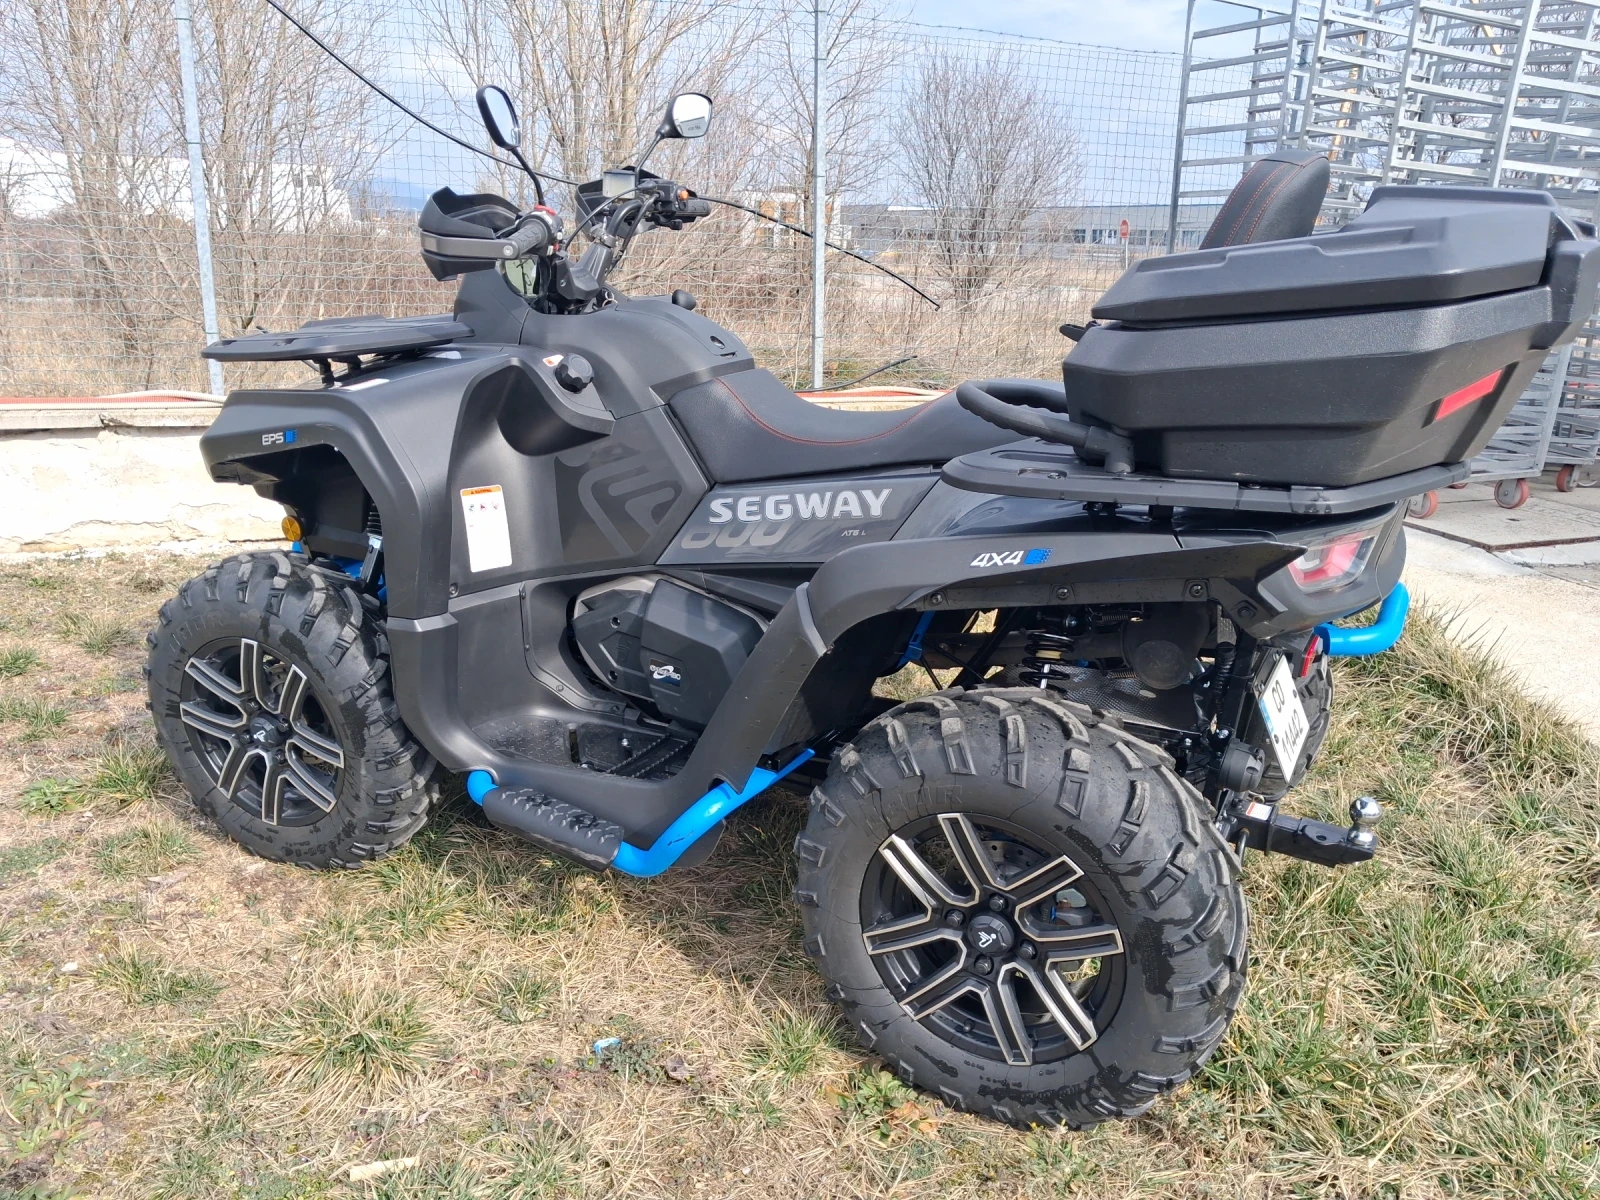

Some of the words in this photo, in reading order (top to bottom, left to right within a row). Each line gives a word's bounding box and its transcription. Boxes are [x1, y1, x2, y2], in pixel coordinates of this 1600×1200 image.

[262, 432, 284, 446] EPS
[708, 488, 893, 524] SEGWAY
[970, 550, 1024, 567] 4X4
[1272, 680, 1285, 713] CO
